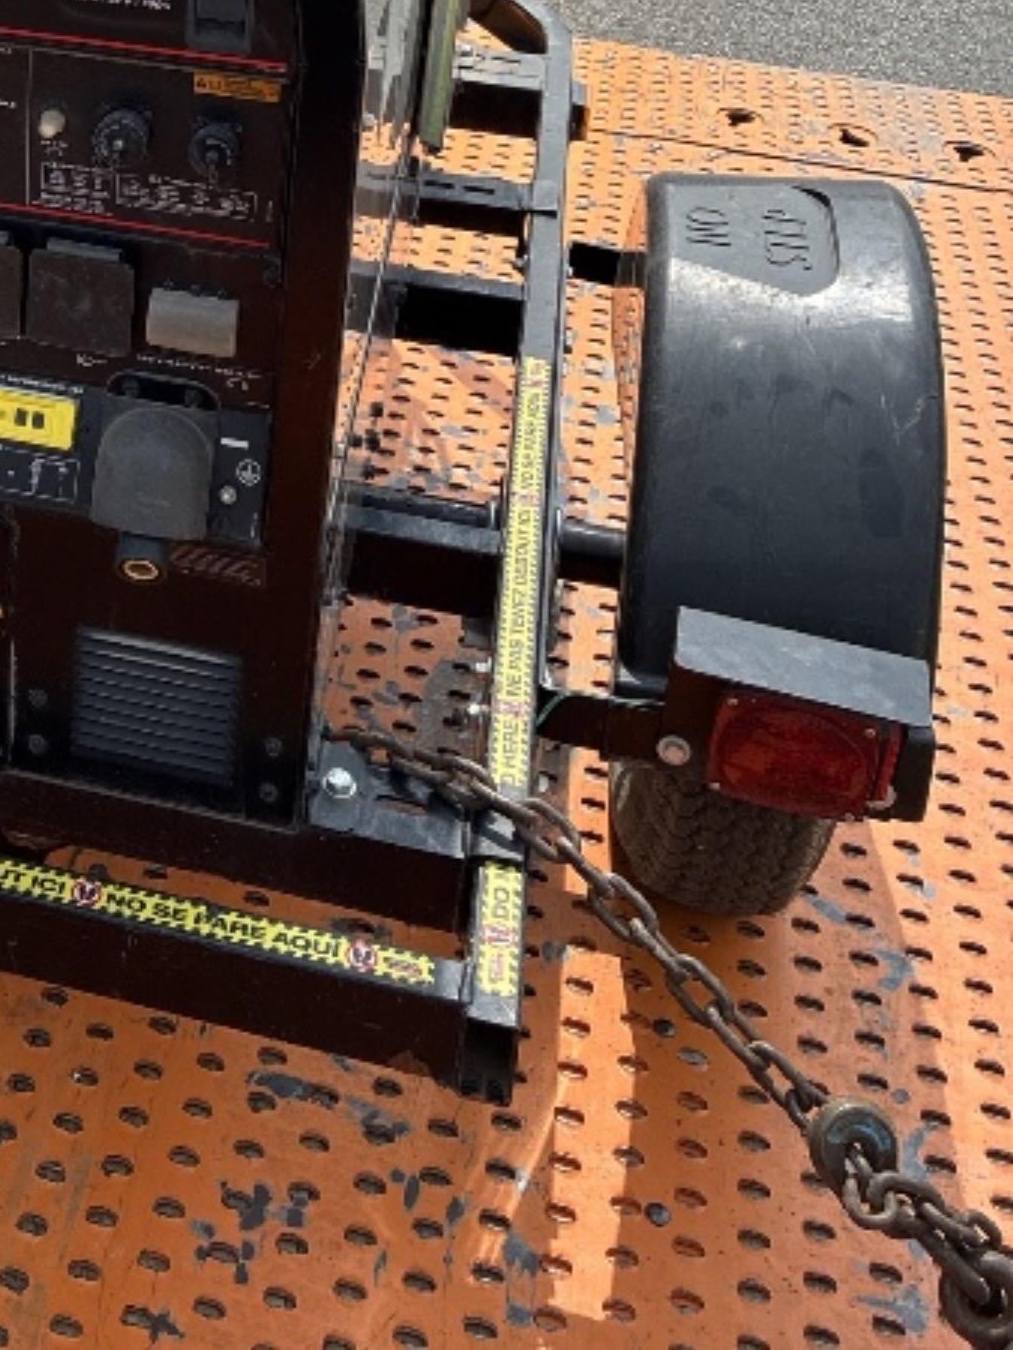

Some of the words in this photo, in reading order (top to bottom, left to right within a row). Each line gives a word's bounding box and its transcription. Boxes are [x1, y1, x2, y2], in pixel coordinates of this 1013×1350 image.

[31, 877, 66, 895] ICI
[106, 893, 147, 913] NO
[153, 902, 186, 921] SE
[271, 929, 340, 958] AQUI
